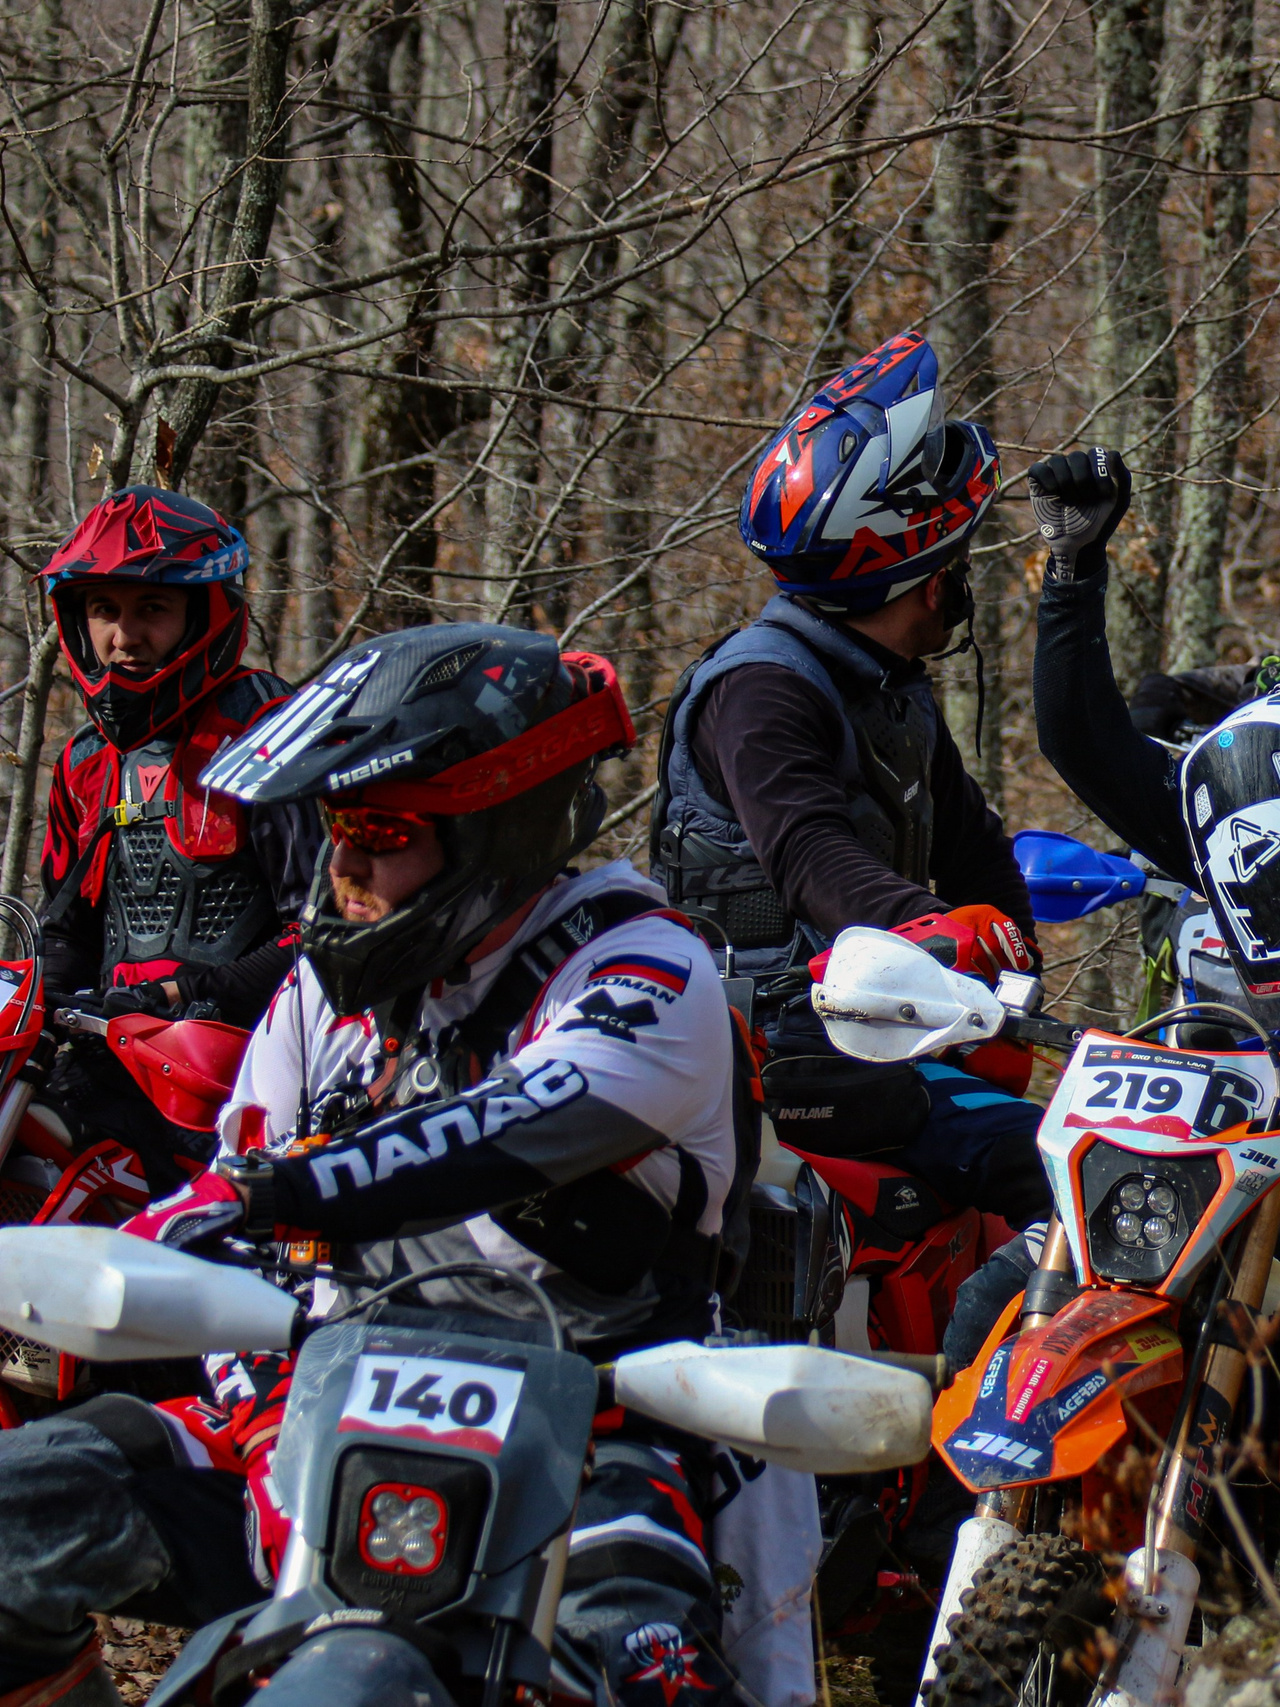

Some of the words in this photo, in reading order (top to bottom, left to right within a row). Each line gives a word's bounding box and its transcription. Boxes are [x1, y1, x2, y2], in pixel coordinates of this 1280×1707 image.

[1003, 920, 1025, 958] starks
[1085, 1071, 1184, 1114] 219
[778, 1106, 835, 1120] INFLAME
[1239, 1148, 1279, 1170] JHL
[368, 1367, 498, 1427] 140
[1011, 1387, 1034, 1421] ENDURO
[1057, 1374, 1107, 1421] ACERBIS
[953, 1430, 1044, 1470] JHL
